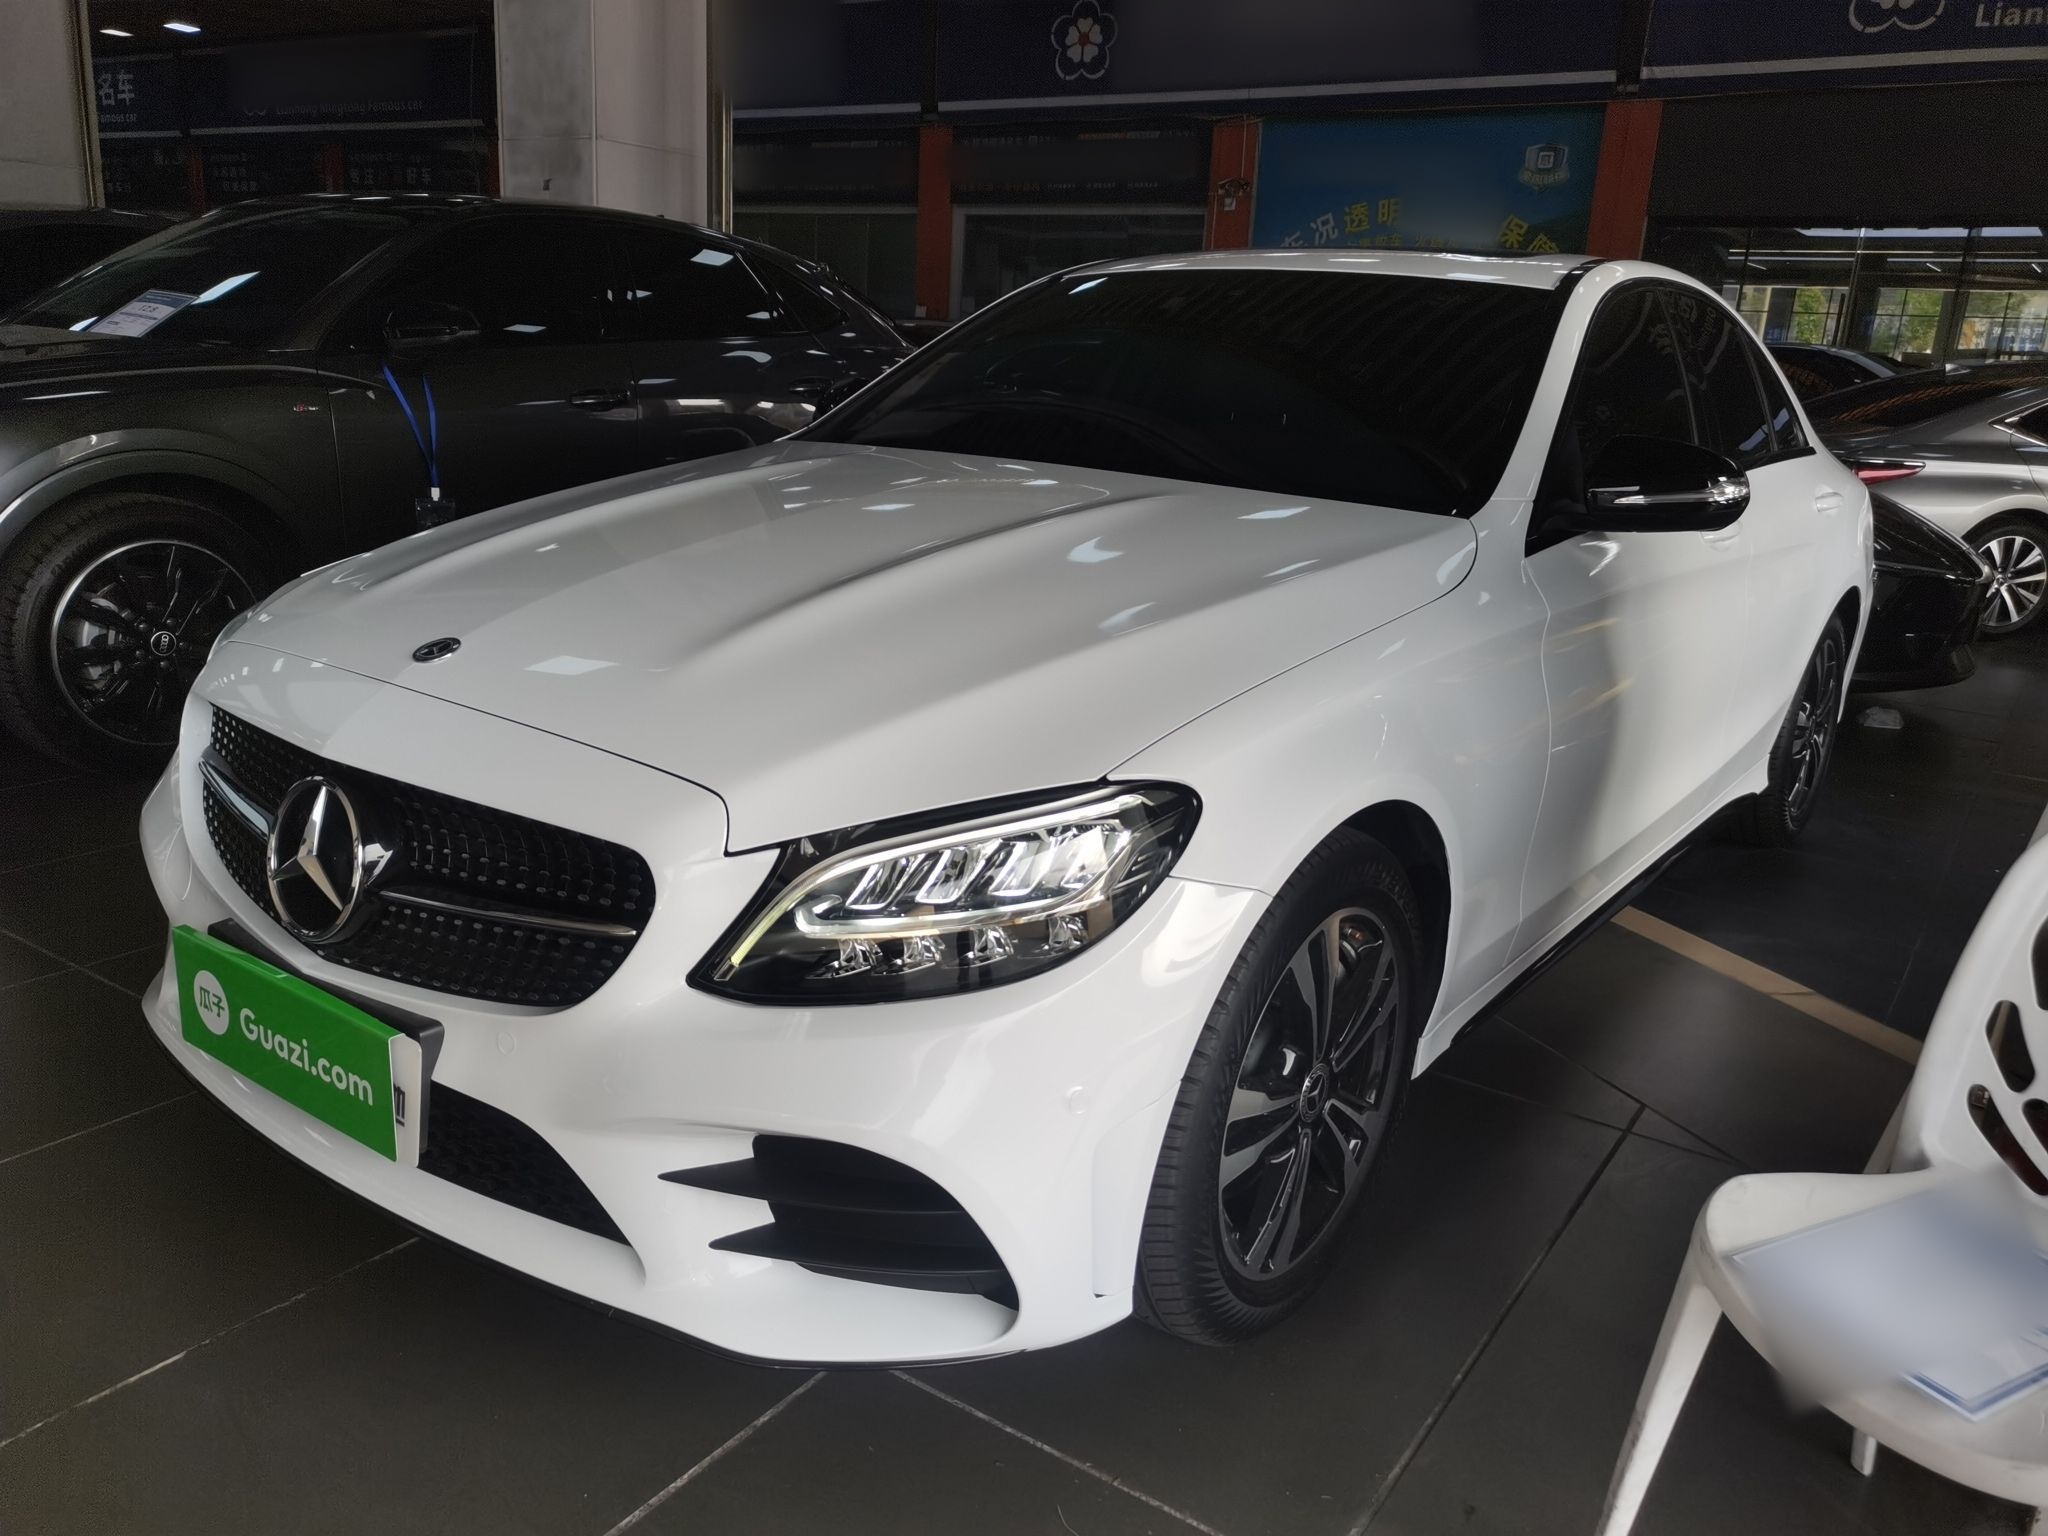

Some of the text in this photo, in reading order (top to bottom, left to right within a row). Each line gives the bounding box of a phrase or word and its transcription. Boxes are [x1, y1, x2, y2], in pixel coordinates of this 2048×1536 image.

[98, 69, 135, 106] 名车
[99, 112, 124, 123] amous
[199, 985, 225, 1018] 瓜子
[240, 1008, 373, 1106] Guazi.com
